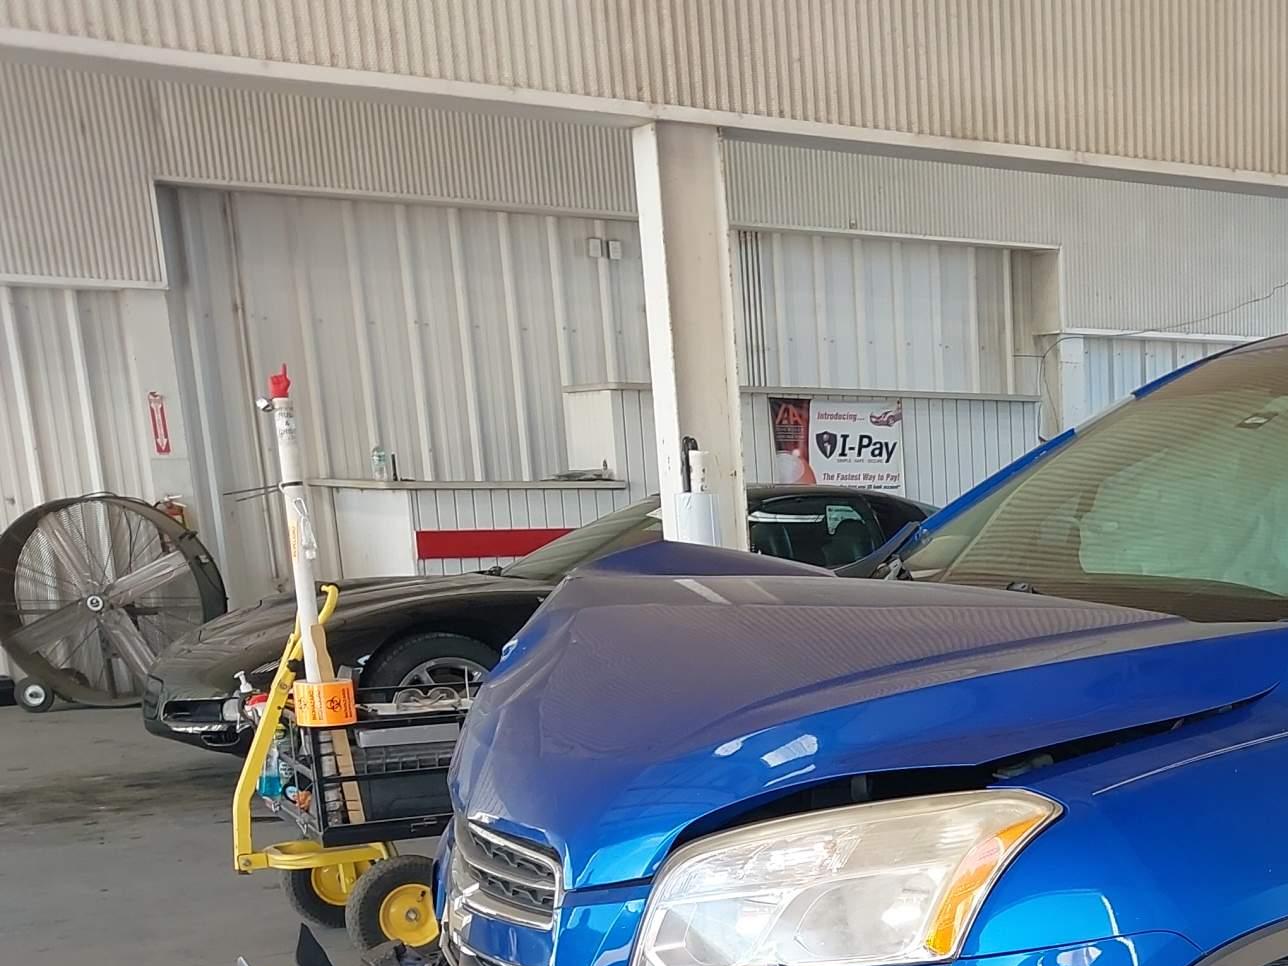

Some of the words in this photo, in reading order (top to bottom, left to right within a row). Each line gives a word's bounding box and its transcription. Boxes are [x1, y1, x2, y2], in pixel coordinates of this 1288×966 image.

[838, 434, 898, 464] I-Pay
[823, 473, 834, 481] The
[836, 473, 861, 481] Fastest
[862, 473, 876, 483] Way
[877, 473, 884, 481] to
[886, 473, 900, 483] Pay!
